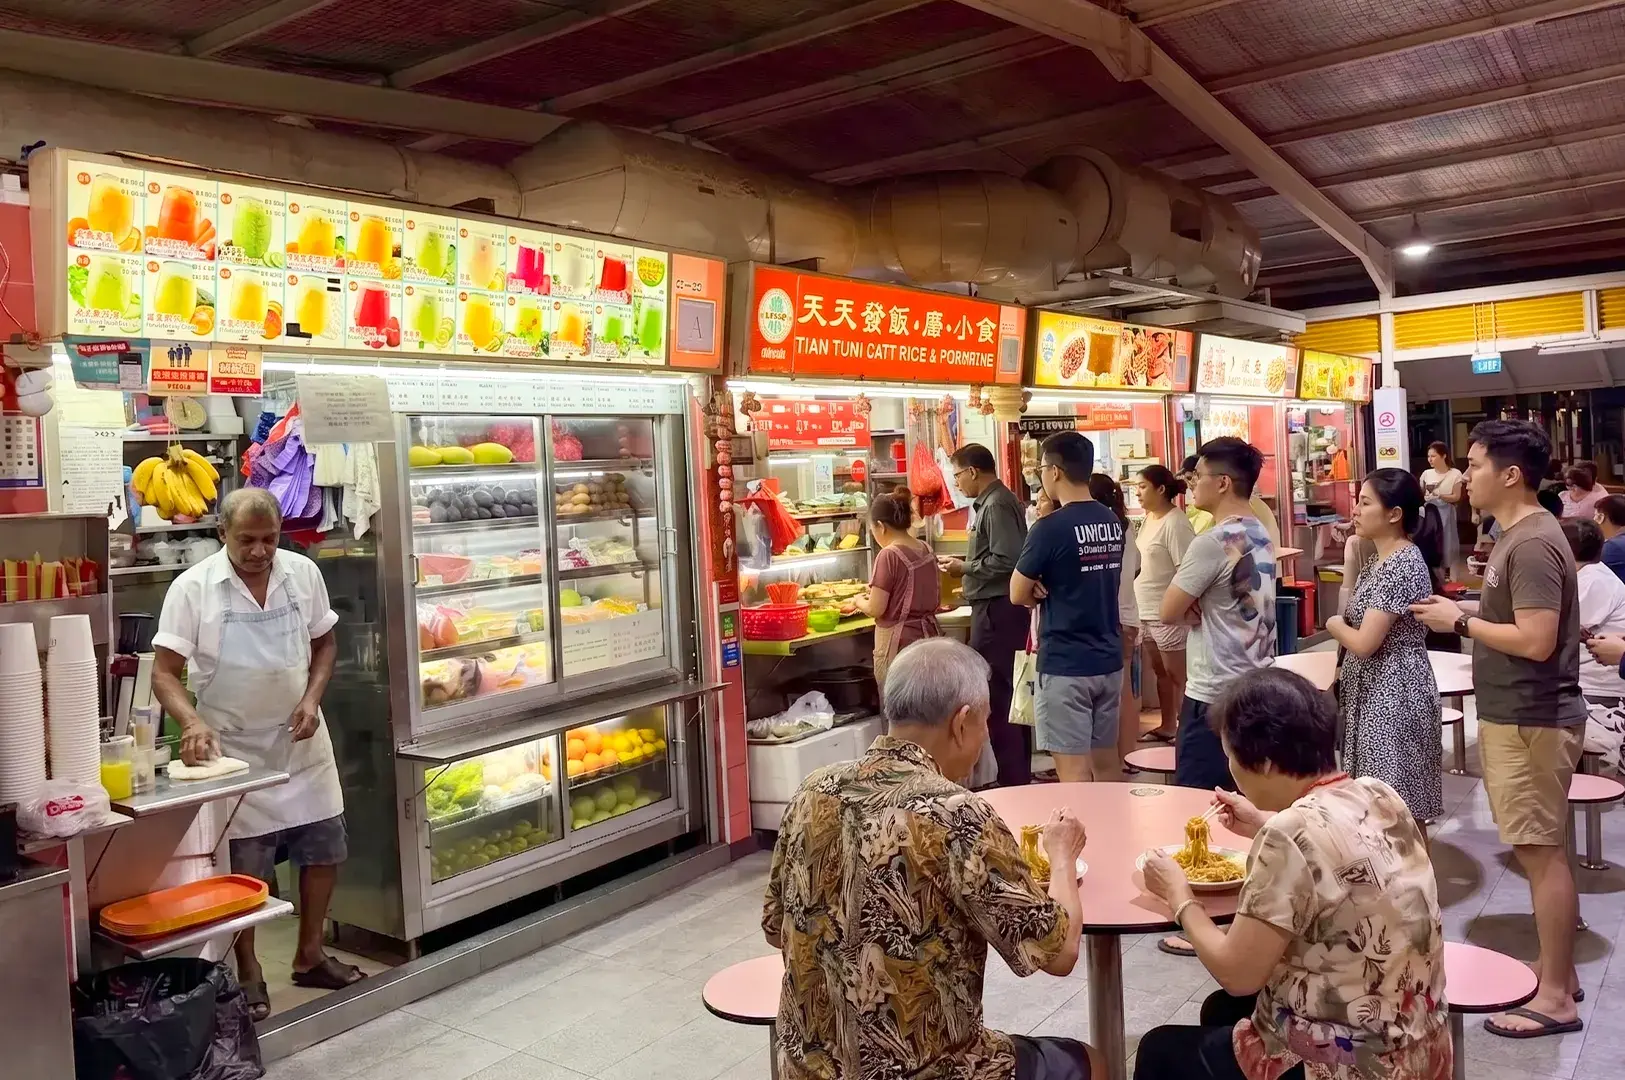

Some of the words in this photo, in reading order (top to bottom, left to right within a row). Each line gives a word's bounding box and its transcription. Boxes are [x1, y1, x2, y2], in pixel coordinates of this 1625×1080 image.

[795, 336, 829, 356] TIAN
[832, 339, 863, 358] TUNI
[866, 343, 897, 361] CATT
[899, 345, 927, 363] RICE
[929, 347, 937, 364] &
